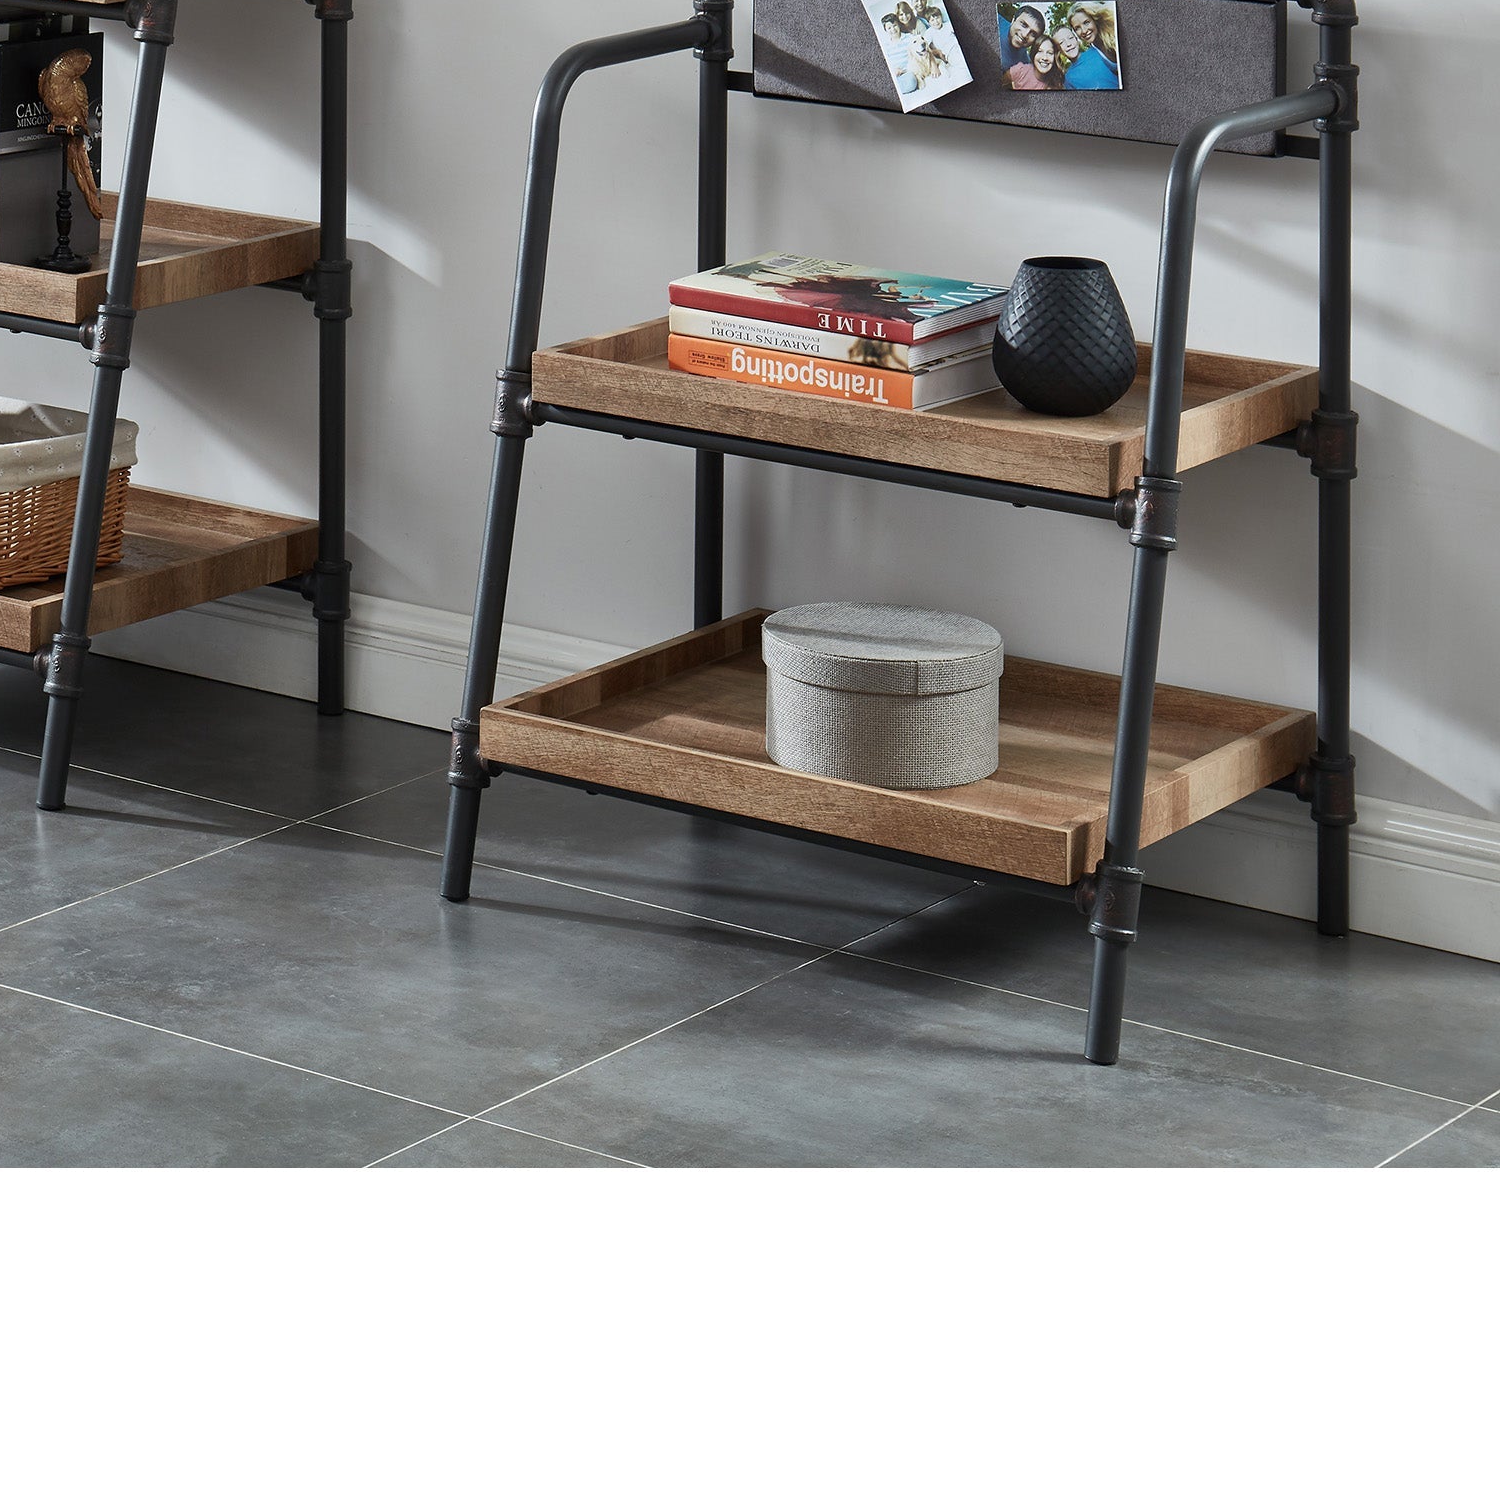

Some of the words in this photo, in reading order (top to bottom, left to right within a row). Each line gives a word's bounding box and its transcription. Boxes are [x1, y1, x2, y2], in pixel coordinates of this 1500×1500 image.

[710, 327, 753, 342] TEORI
[738, 323, 775, 335] GJENNOM
[817, 312, 887, 338] TIME
[755, 334, 821, 353] DARWINS
[731, 347, 889, 405] Trainspotting
